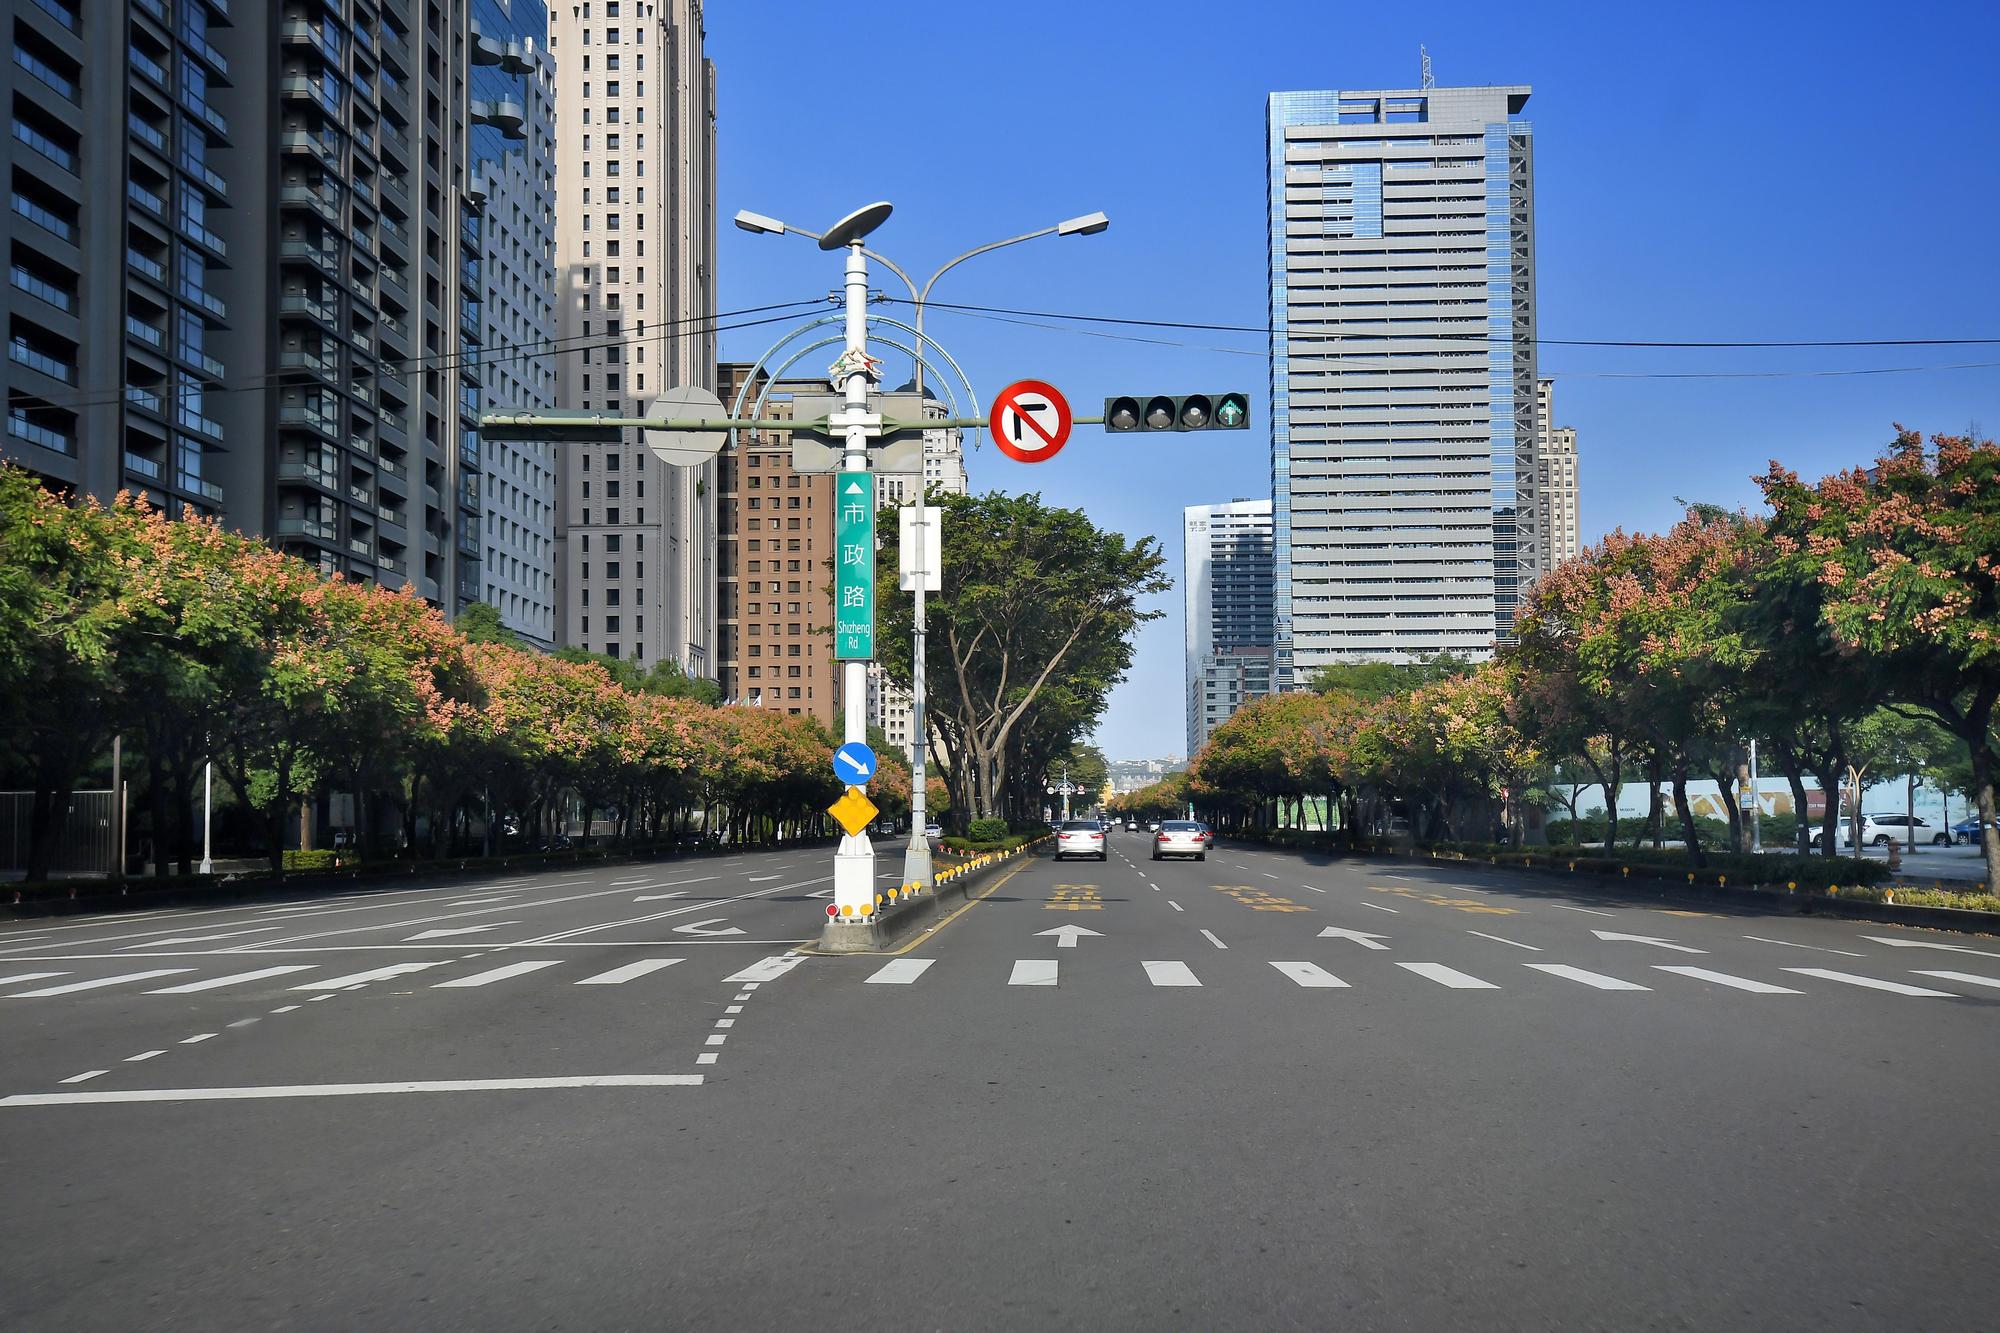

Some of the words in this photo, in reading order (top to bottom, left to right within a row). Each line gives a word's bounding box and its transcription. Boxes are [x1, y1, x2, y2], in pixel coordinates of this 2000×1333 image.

[843, 502, 865, 608] 市政路
[838, 620, 870, 638] Shizheng
[848, 636, 858, 649] Rd
